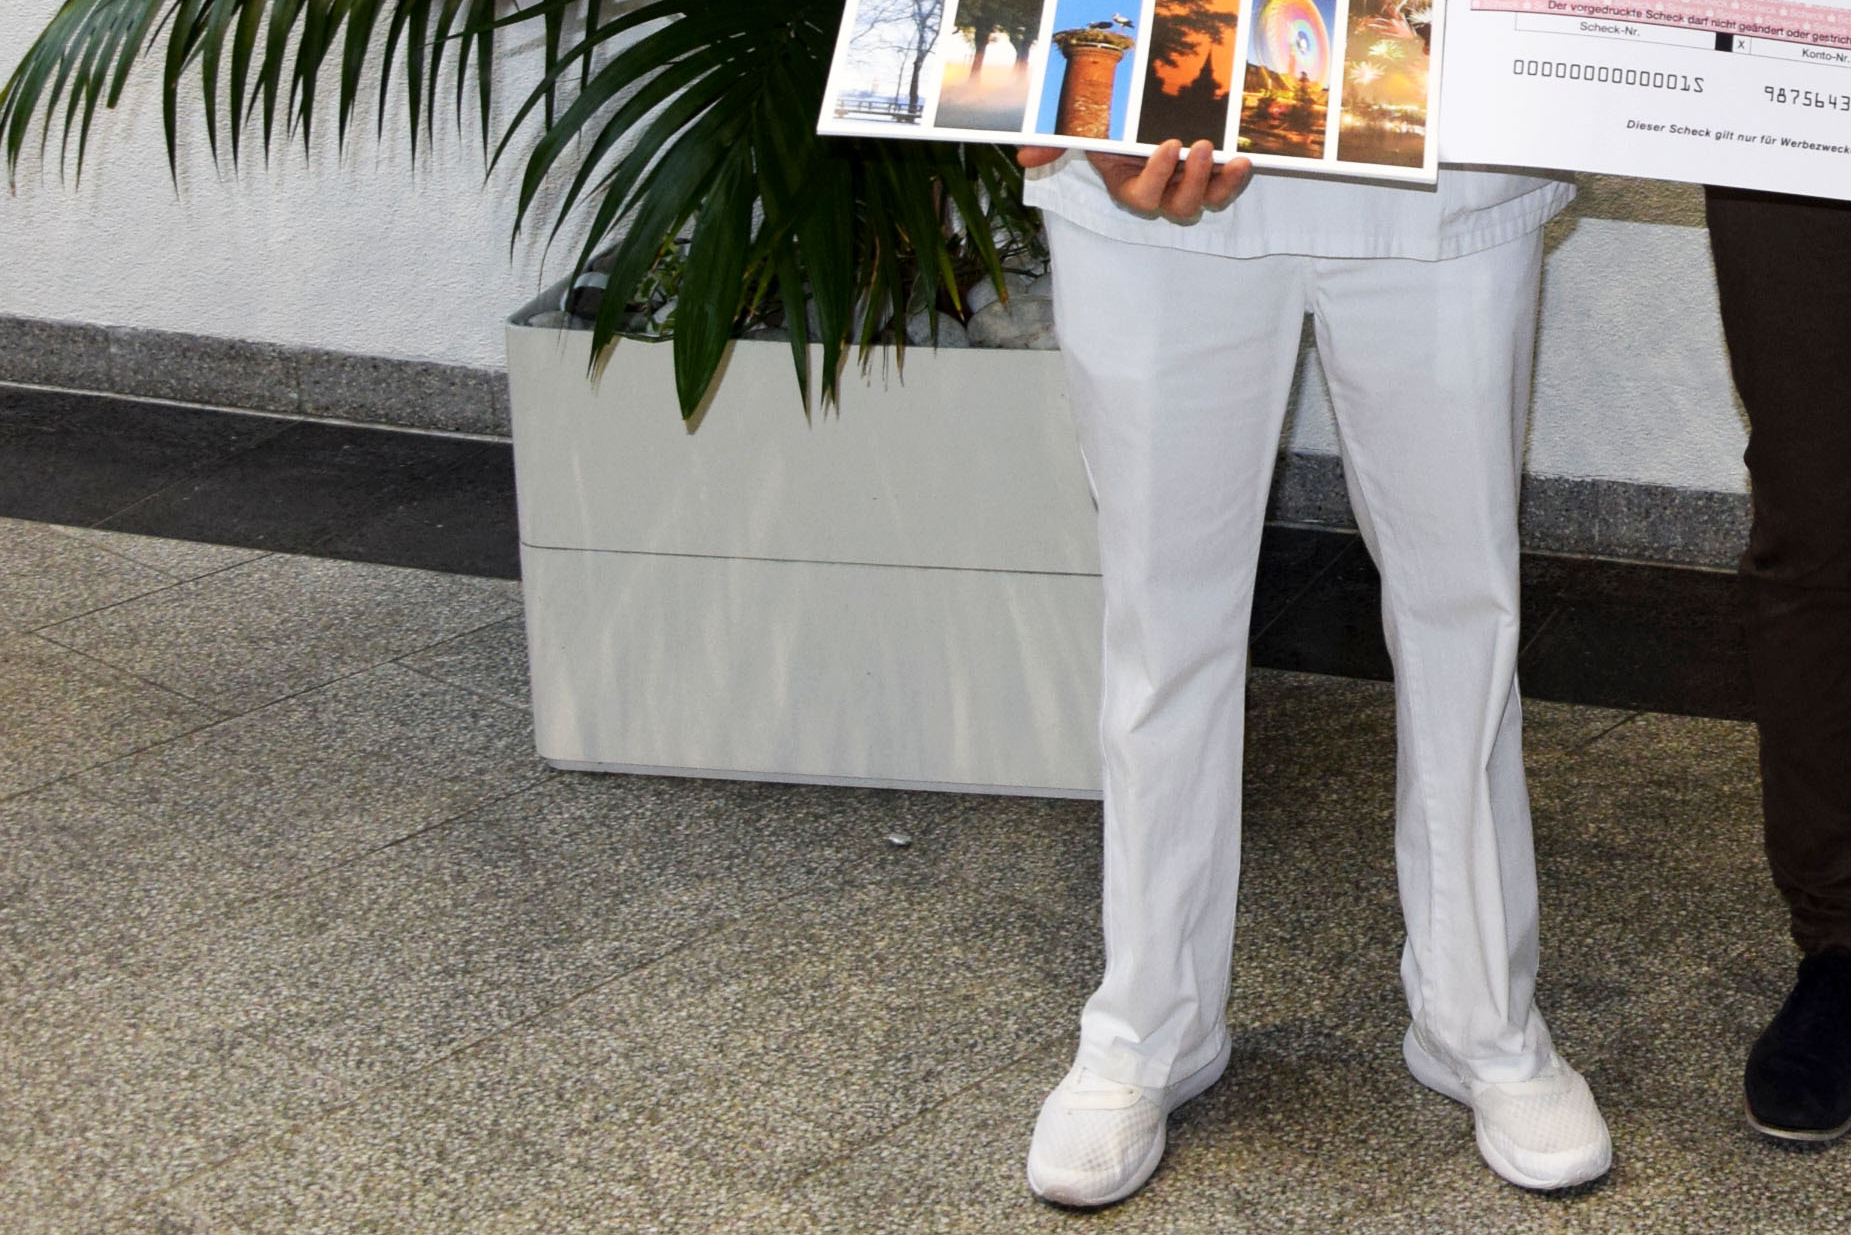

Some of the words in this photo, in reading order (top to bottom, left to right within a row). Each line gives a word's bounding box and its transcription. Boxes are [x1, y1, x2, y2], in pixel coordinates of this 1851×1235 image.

[1548, 0, 1567, 10] Der
[1571, 3, 1642, 18] vorgedruckte
[1646, 9, 1684, 23] Scheck
[1687, 16, 1709, 25] darf
[1711, 19, 1736, 29] nicht
[1739, 22, 1784, 36] geändert
[1786, 28, 1809, 39] oder
[1580, 21, 1640, 36] Scheck-Nr.
[1802, 48, 1851, 63] Konto-Nr.
[1626, 119, 1666, 132] Dieser
[1668, 123, 1712, 138] Scheck
[1714, 130, 1735, 141] gilt
[1737, 133, 1758, 143] nur
[1759, 134, 1778, 145] für
